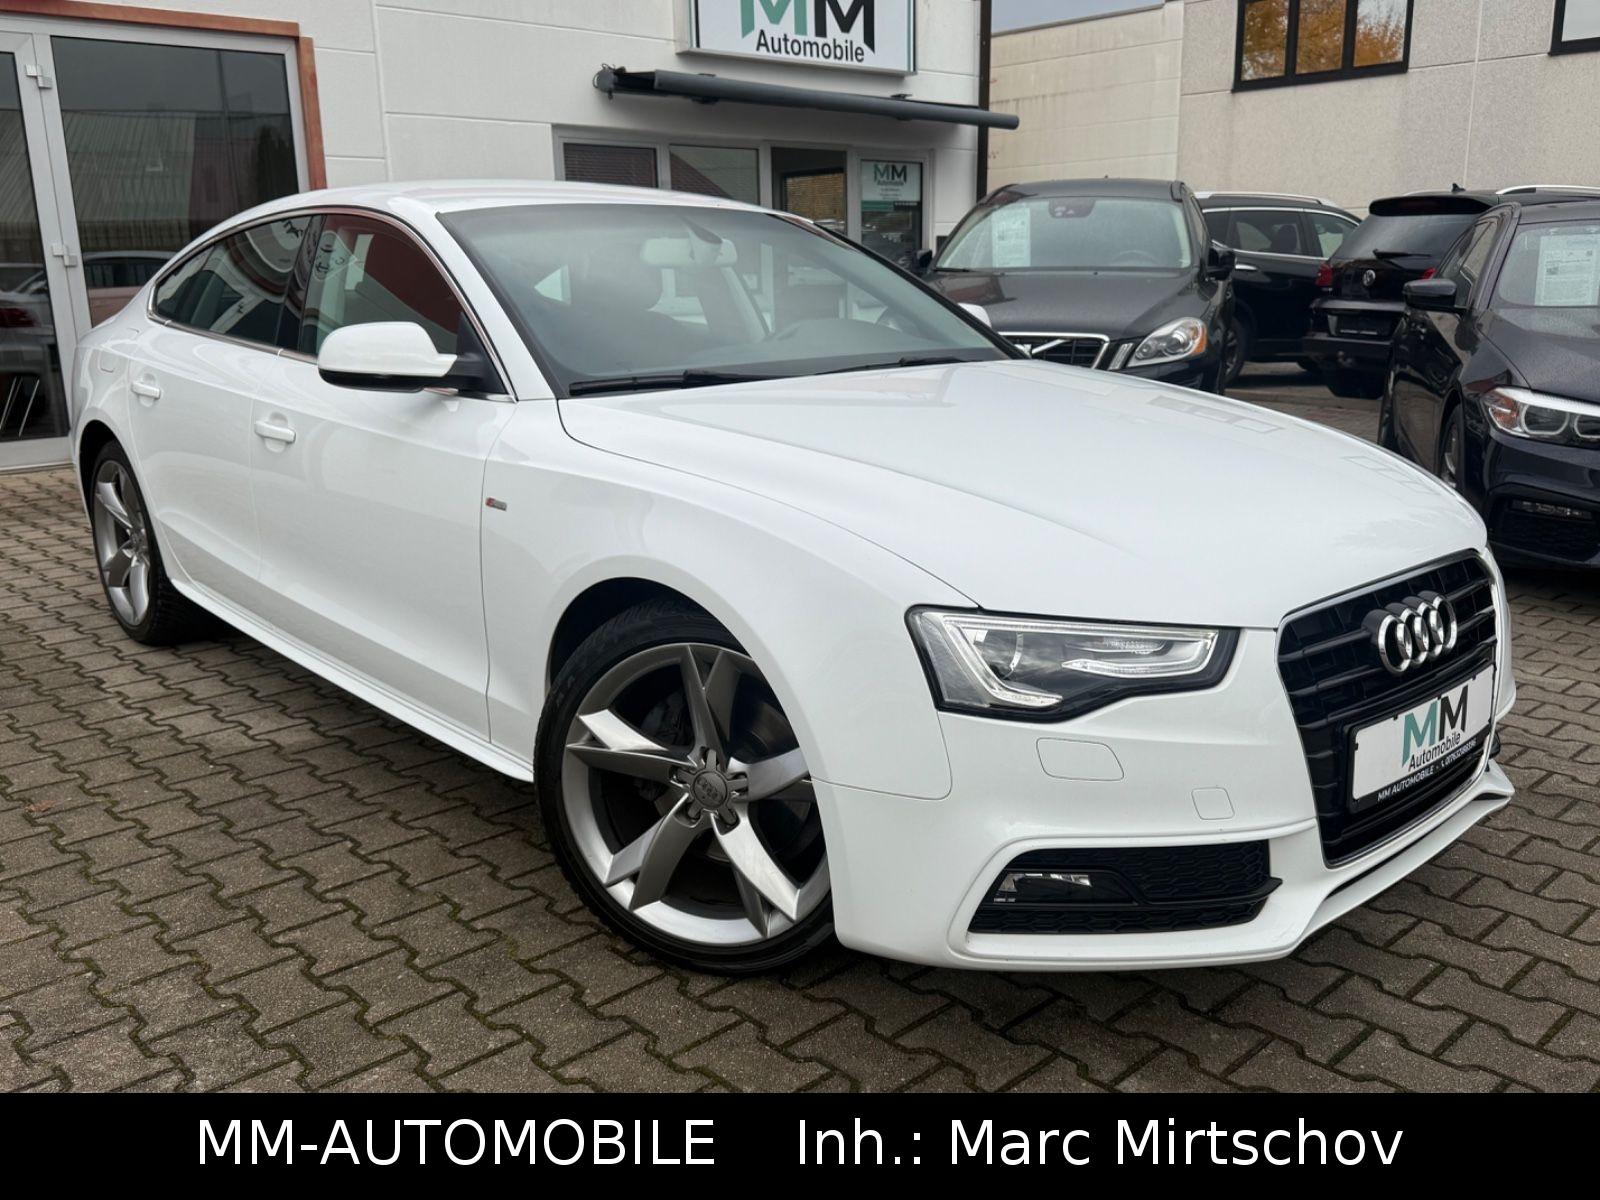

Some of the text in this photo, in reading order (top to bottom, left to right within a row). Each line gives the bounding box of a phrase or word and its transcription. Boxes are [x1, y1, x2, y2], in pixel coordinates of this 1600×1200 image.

[756, 29, 865, 62] Automobile
[873, 164, 907, 184] MM
[1402, 684, 1469, 768] MM
[1408, 732, 1461, 772] Automobile
[1377, 765, 1434, 801] MM AUTOMOBILE
